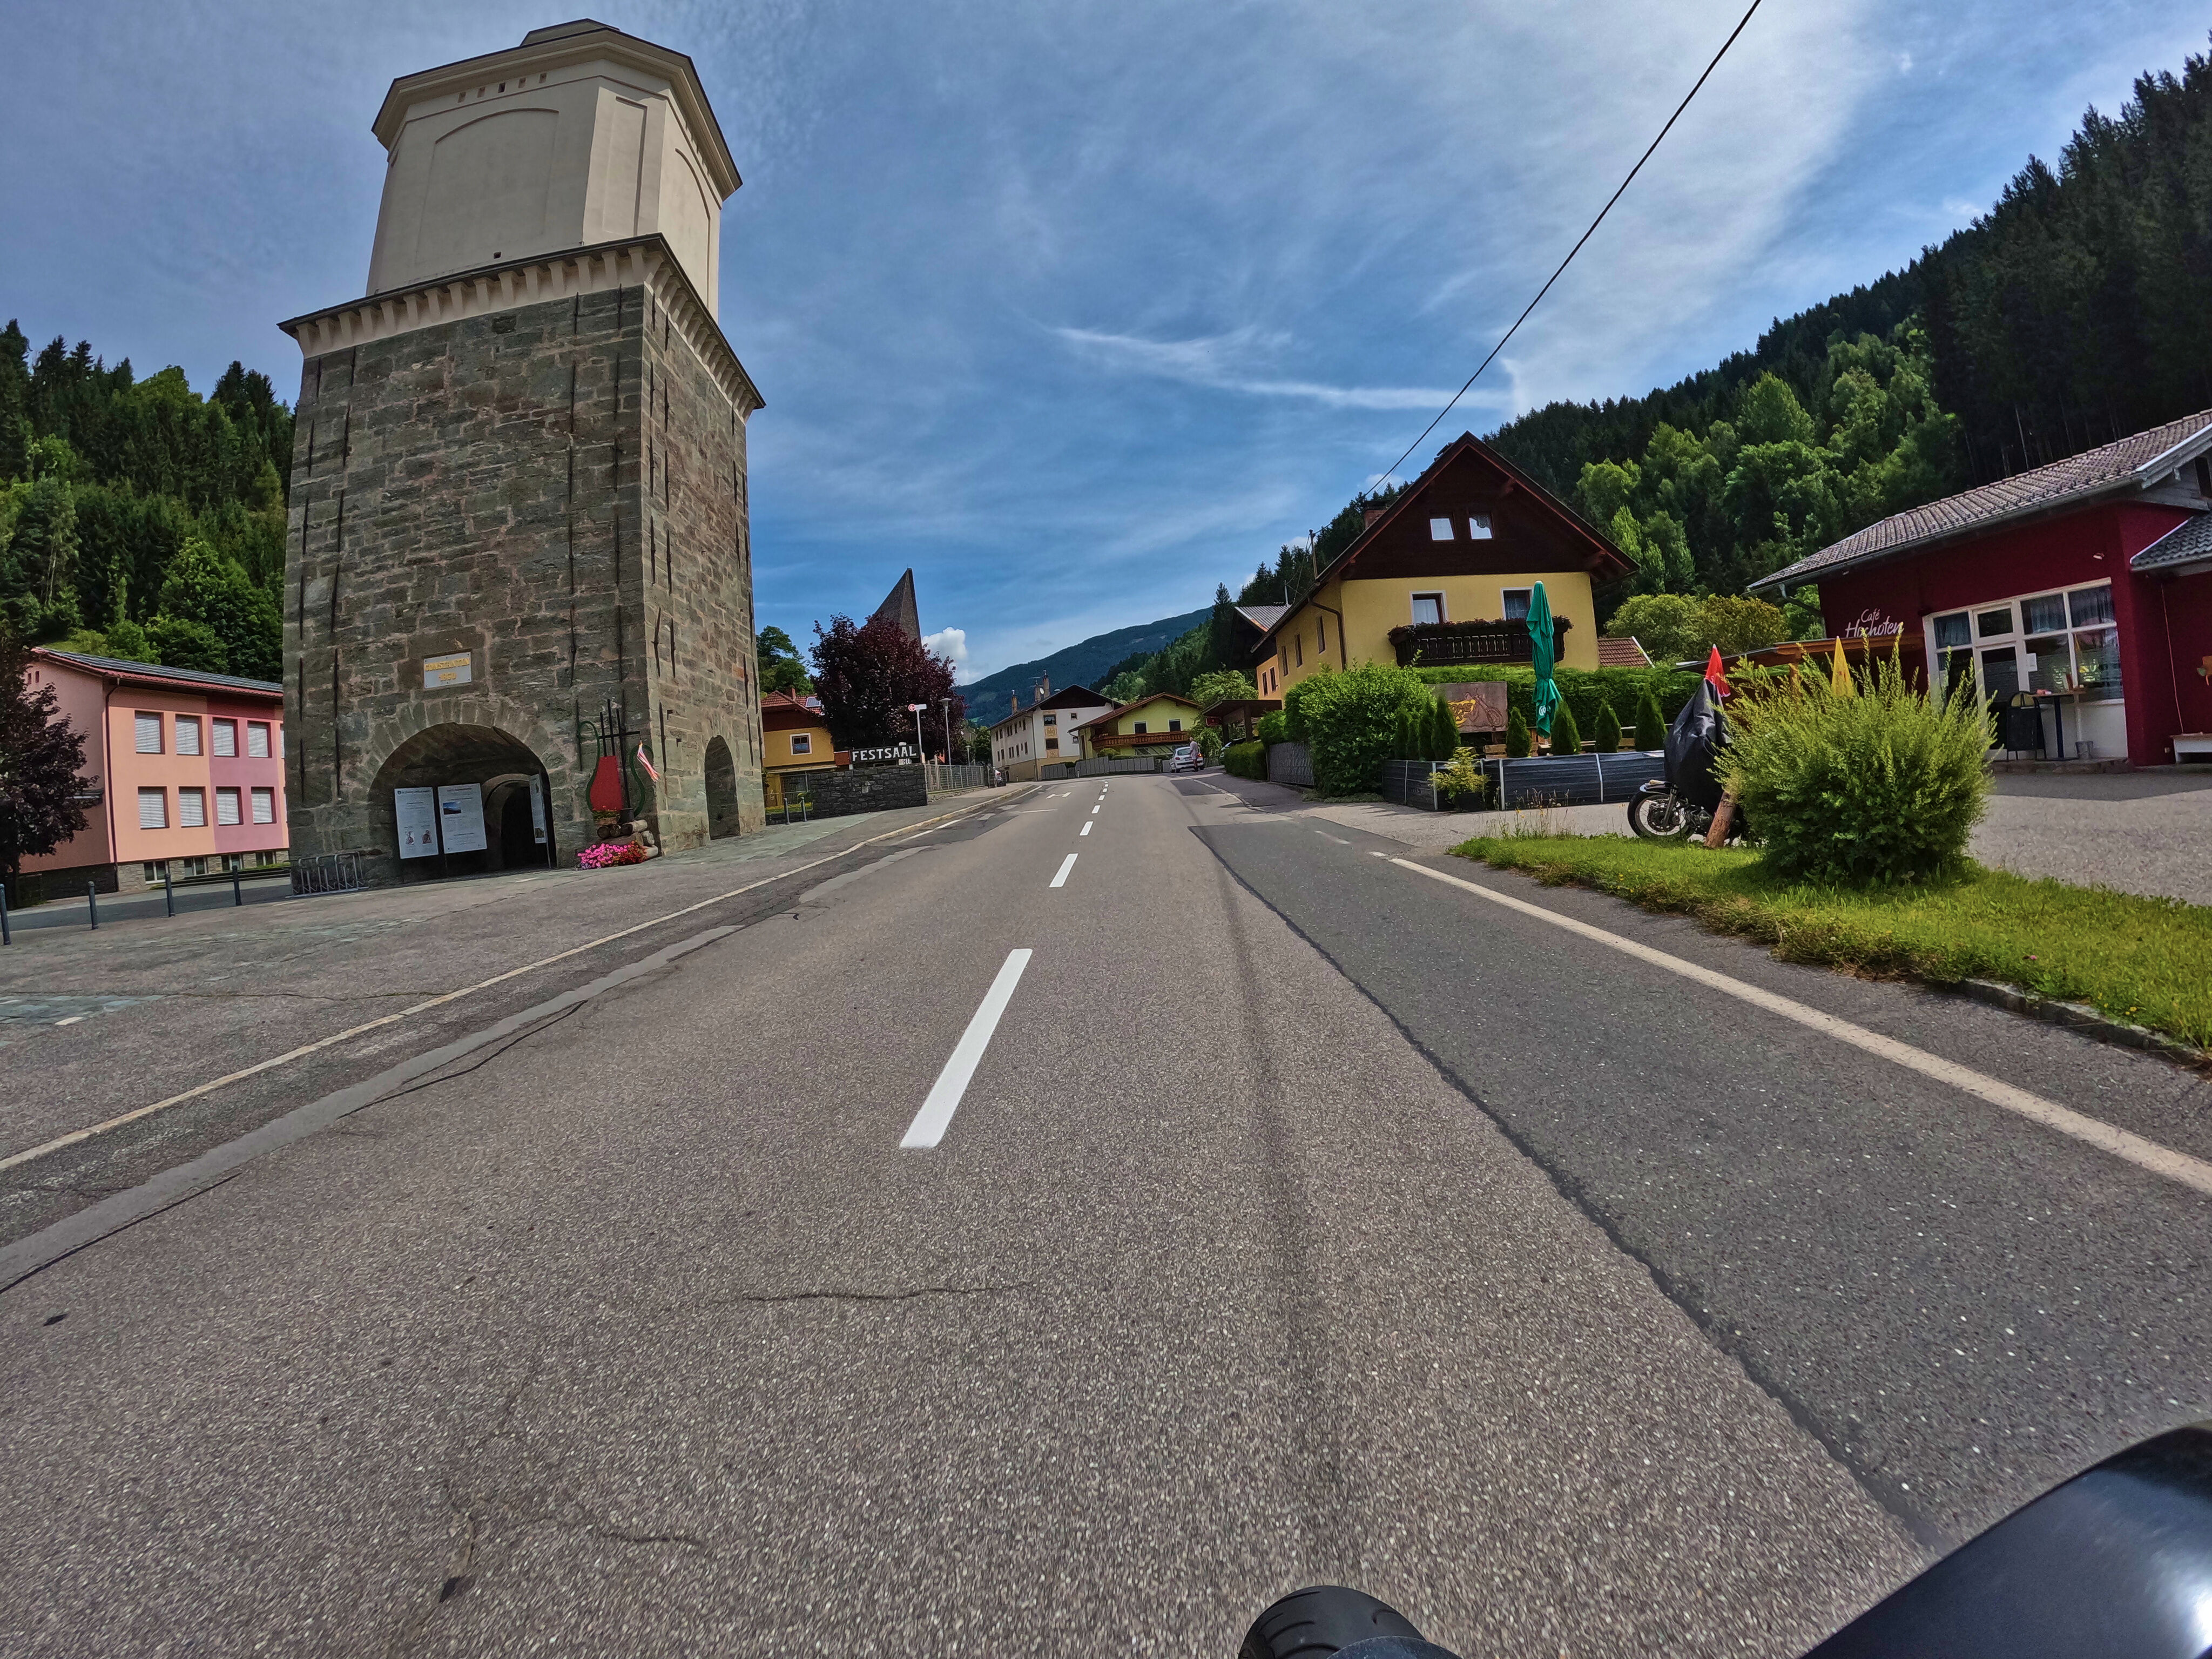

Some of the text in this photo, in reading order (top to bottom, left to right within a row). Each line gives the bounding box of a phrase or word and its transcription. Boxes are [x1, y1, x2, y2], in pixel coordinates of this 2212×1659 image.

[1861, 608, 1880, 625] Café
[424, 658, 470, 671] CONSTANTIN
[852, 746, 917, 761] FESTSAAL
